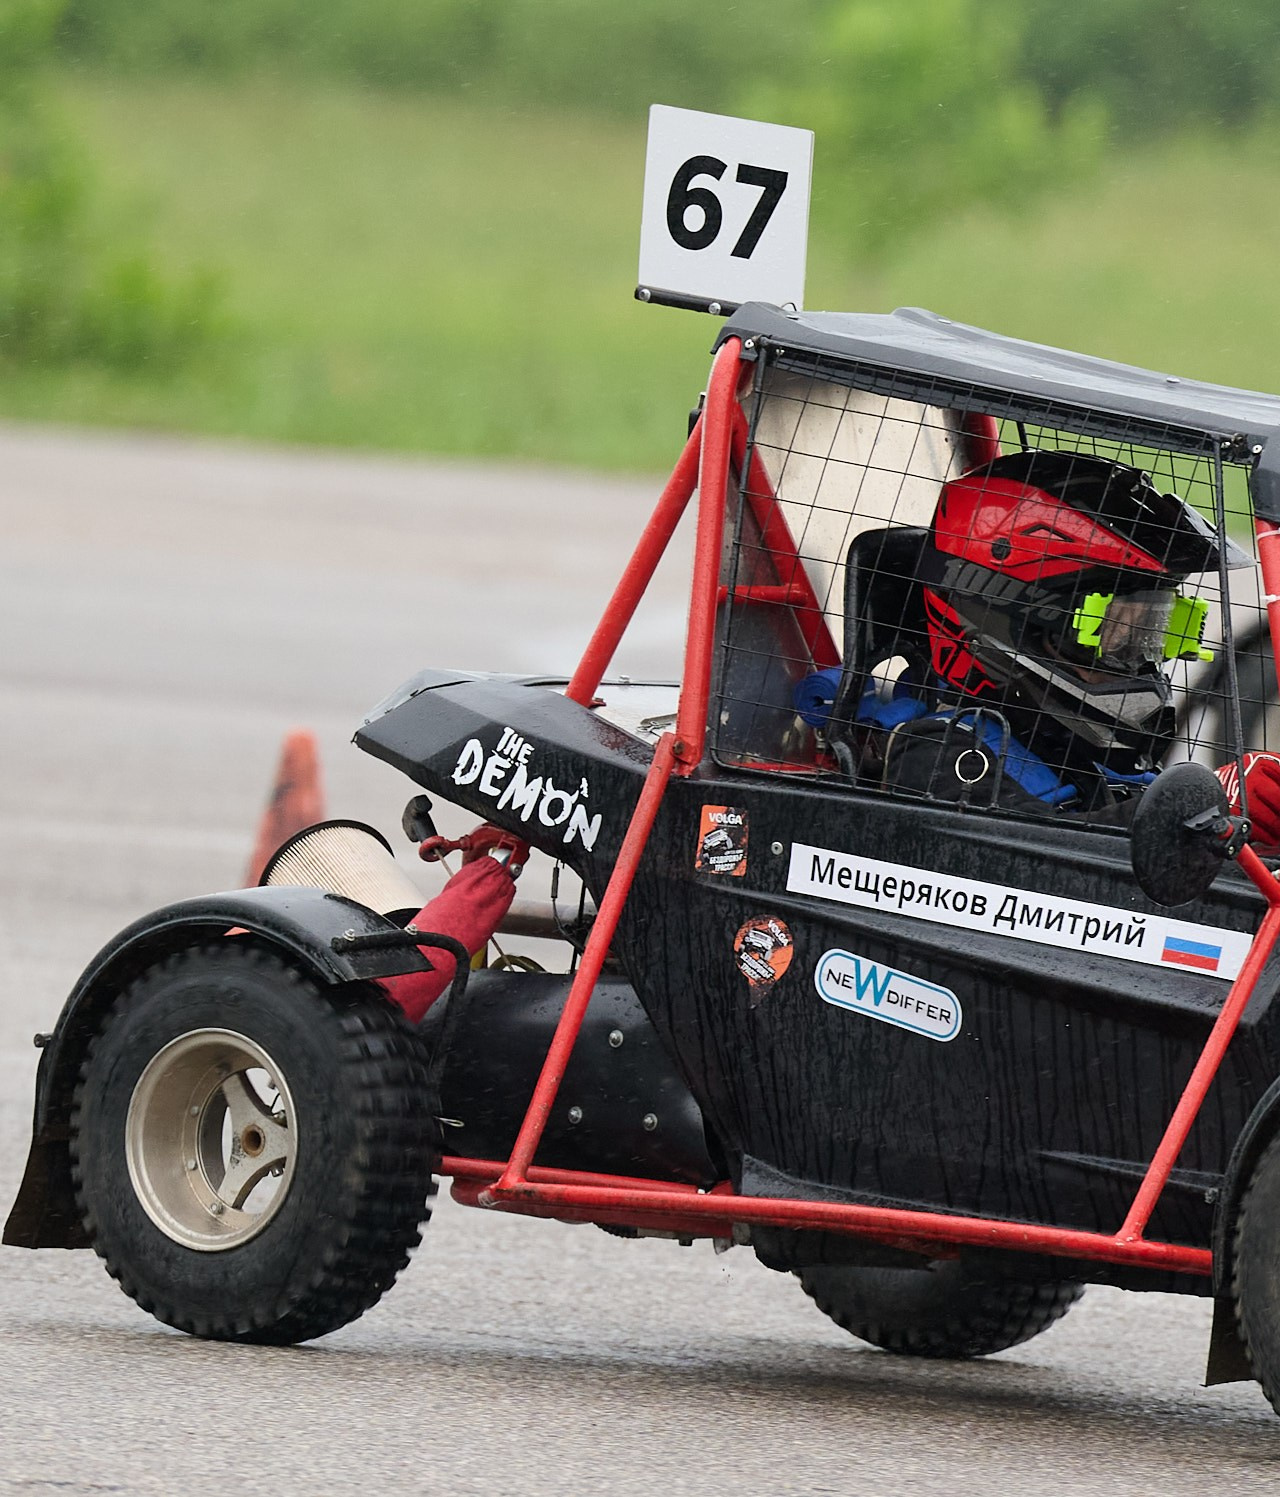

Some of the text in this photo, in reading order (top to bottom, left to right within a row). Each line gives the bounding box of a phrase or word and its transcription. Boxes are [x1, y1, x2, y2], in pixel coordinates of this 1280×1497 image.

[666, 154, 789, 260] 67
[941, 558, 1063, 622] 100%
[496, 726, 535, 764] THE
[451, 738, 603, 853] DEMON
[708, 812, 743, 825] VOLGA
[810, 854, 1148, 948] Мещеряков Дмитрий
[768, 920, 789, 947] VOLGA
